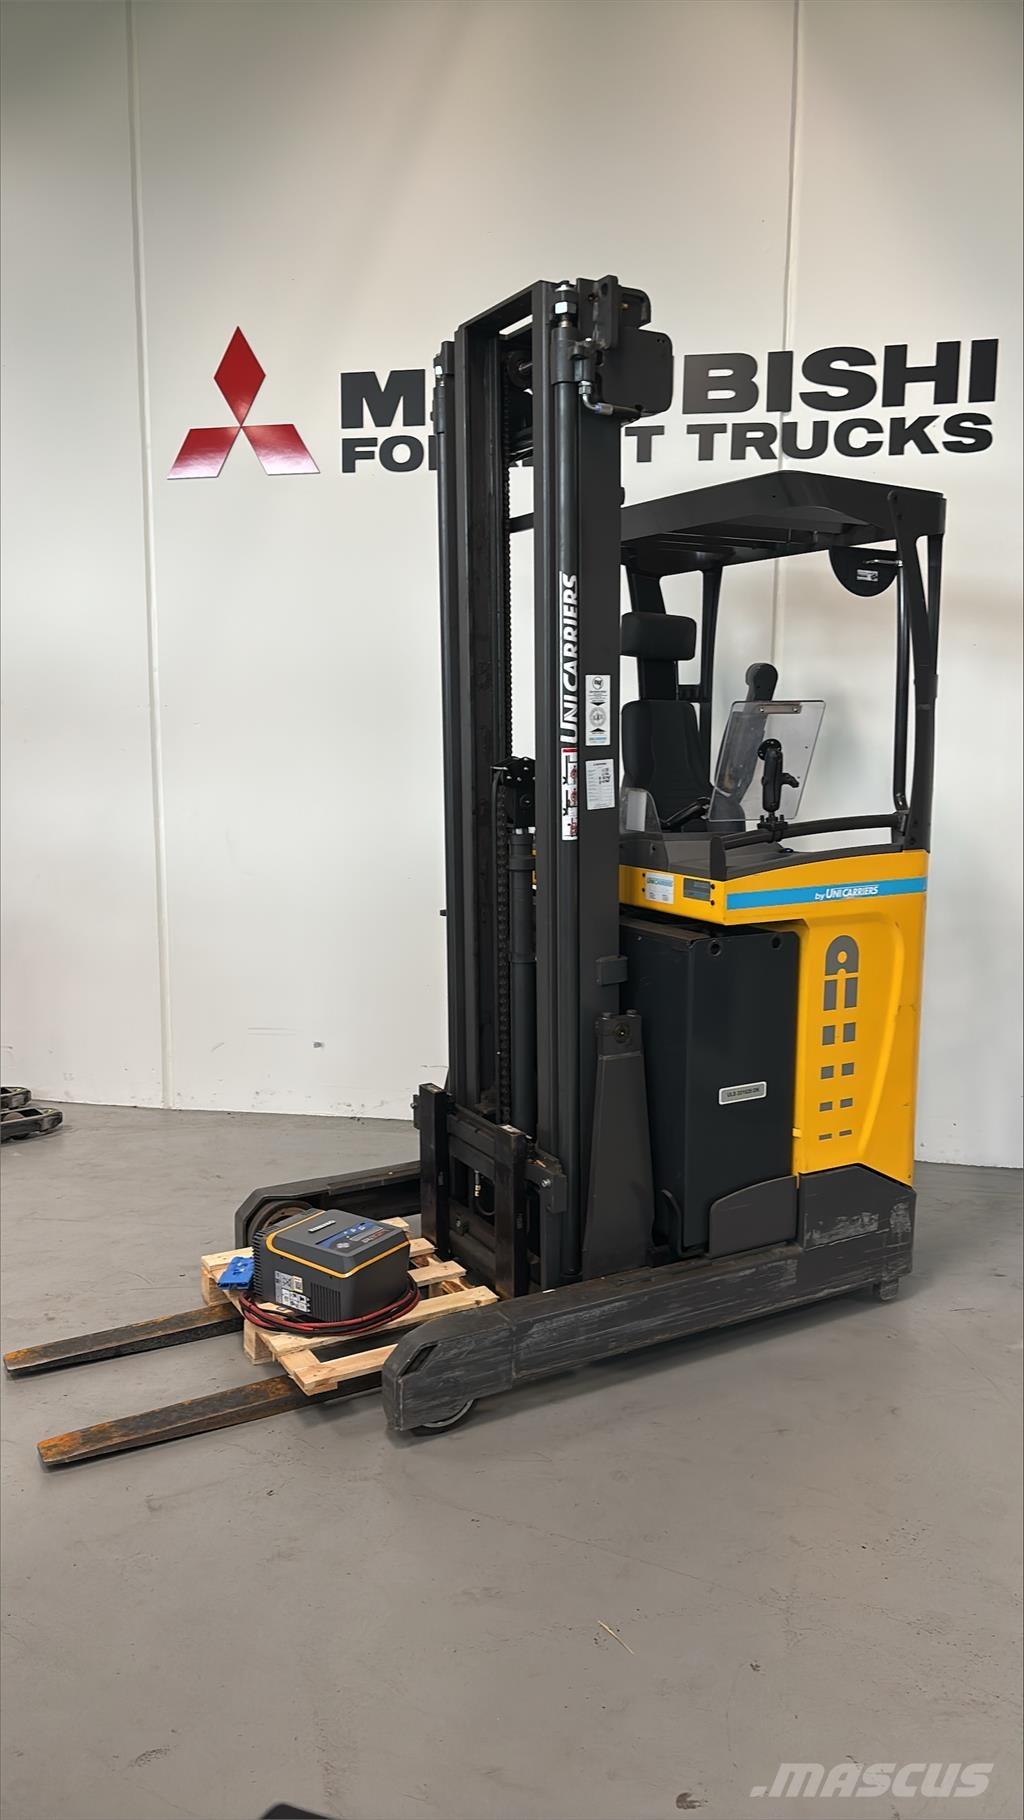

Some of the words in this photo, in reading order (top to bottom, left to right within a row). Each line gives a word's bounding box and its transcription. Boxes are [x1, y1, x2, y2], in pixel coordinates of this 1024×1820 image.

[341, 339, 999, 429] MBISHI
[686, 412, 994, 462] TRUCKS
[559, 571, 578, 743] UNICARRIERS
[815, 892, 825, 901] by
[826, 885, 879, 898] UNICARRIERS
